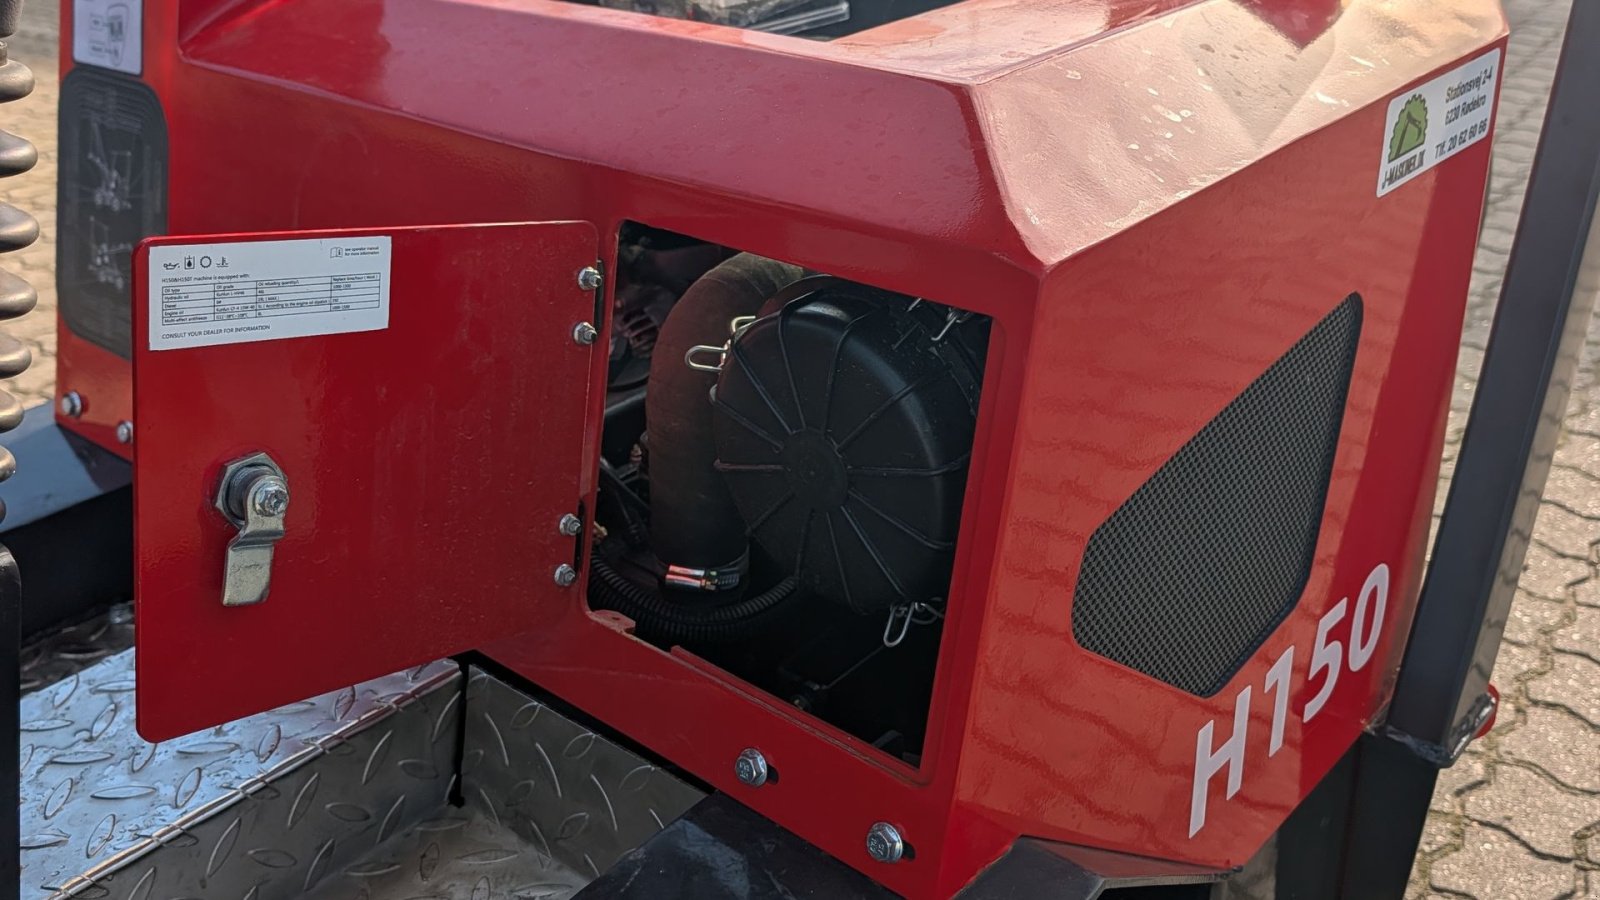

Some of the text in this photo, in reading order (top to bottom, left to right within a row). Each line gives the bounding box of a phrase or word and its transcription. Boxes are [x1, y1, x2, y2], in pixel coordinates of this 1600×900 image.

[1446, 71, 1482, 103] Stationsvej
[1445, 104, 1460, 125] 6230
[1447, 134, 1457, 152] 20
[1458, 129, 1468, 146] 62
[162, 332, 186, 340] CONSULT
[204, 328, 222, 336] DEALER
[235, 324, 270, 332] INFORMATION
[1188, 562, 1390, 839] H150
